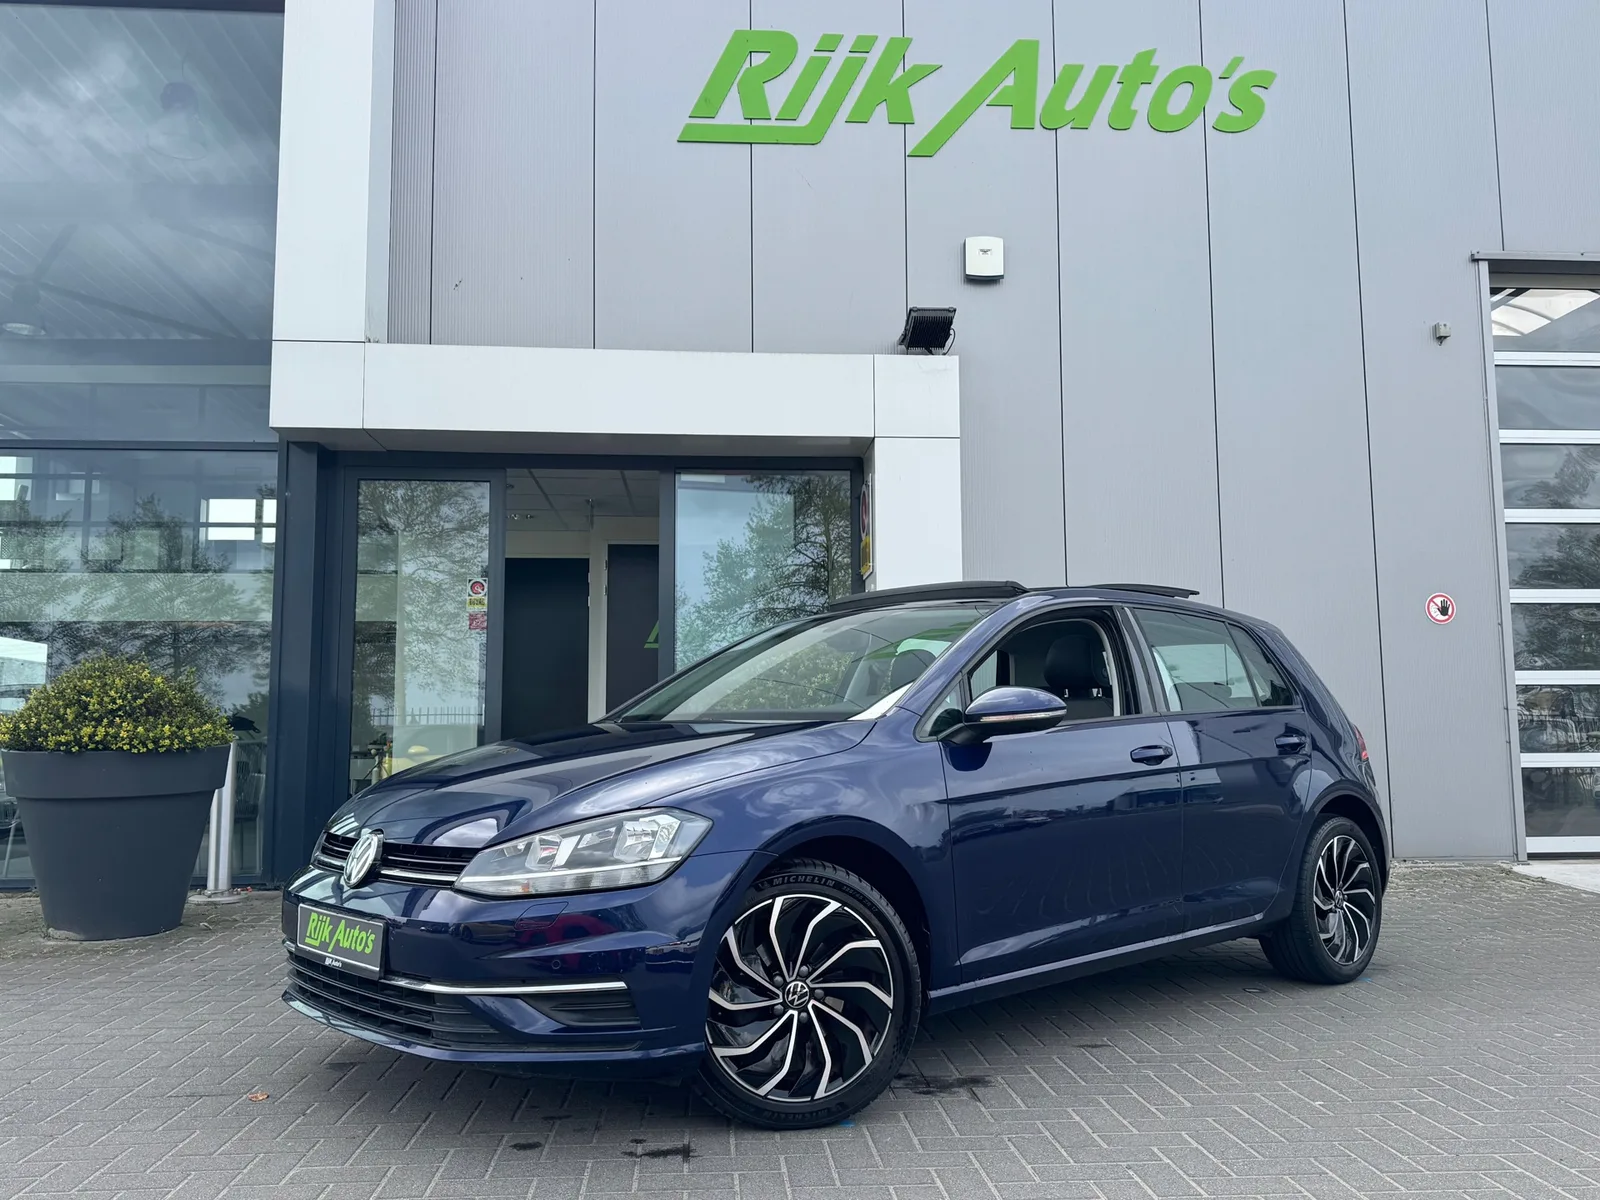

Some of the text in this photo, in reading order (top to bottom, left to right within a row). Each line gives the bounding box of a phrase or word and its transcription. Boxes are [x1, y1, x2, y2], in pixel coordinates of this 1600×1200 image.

[677, 29, 1278, 158] Rijk Auto's
[772, 875, 836, 887] MICHELIN
[304, 911, 376, 954] Rijk Auto's
